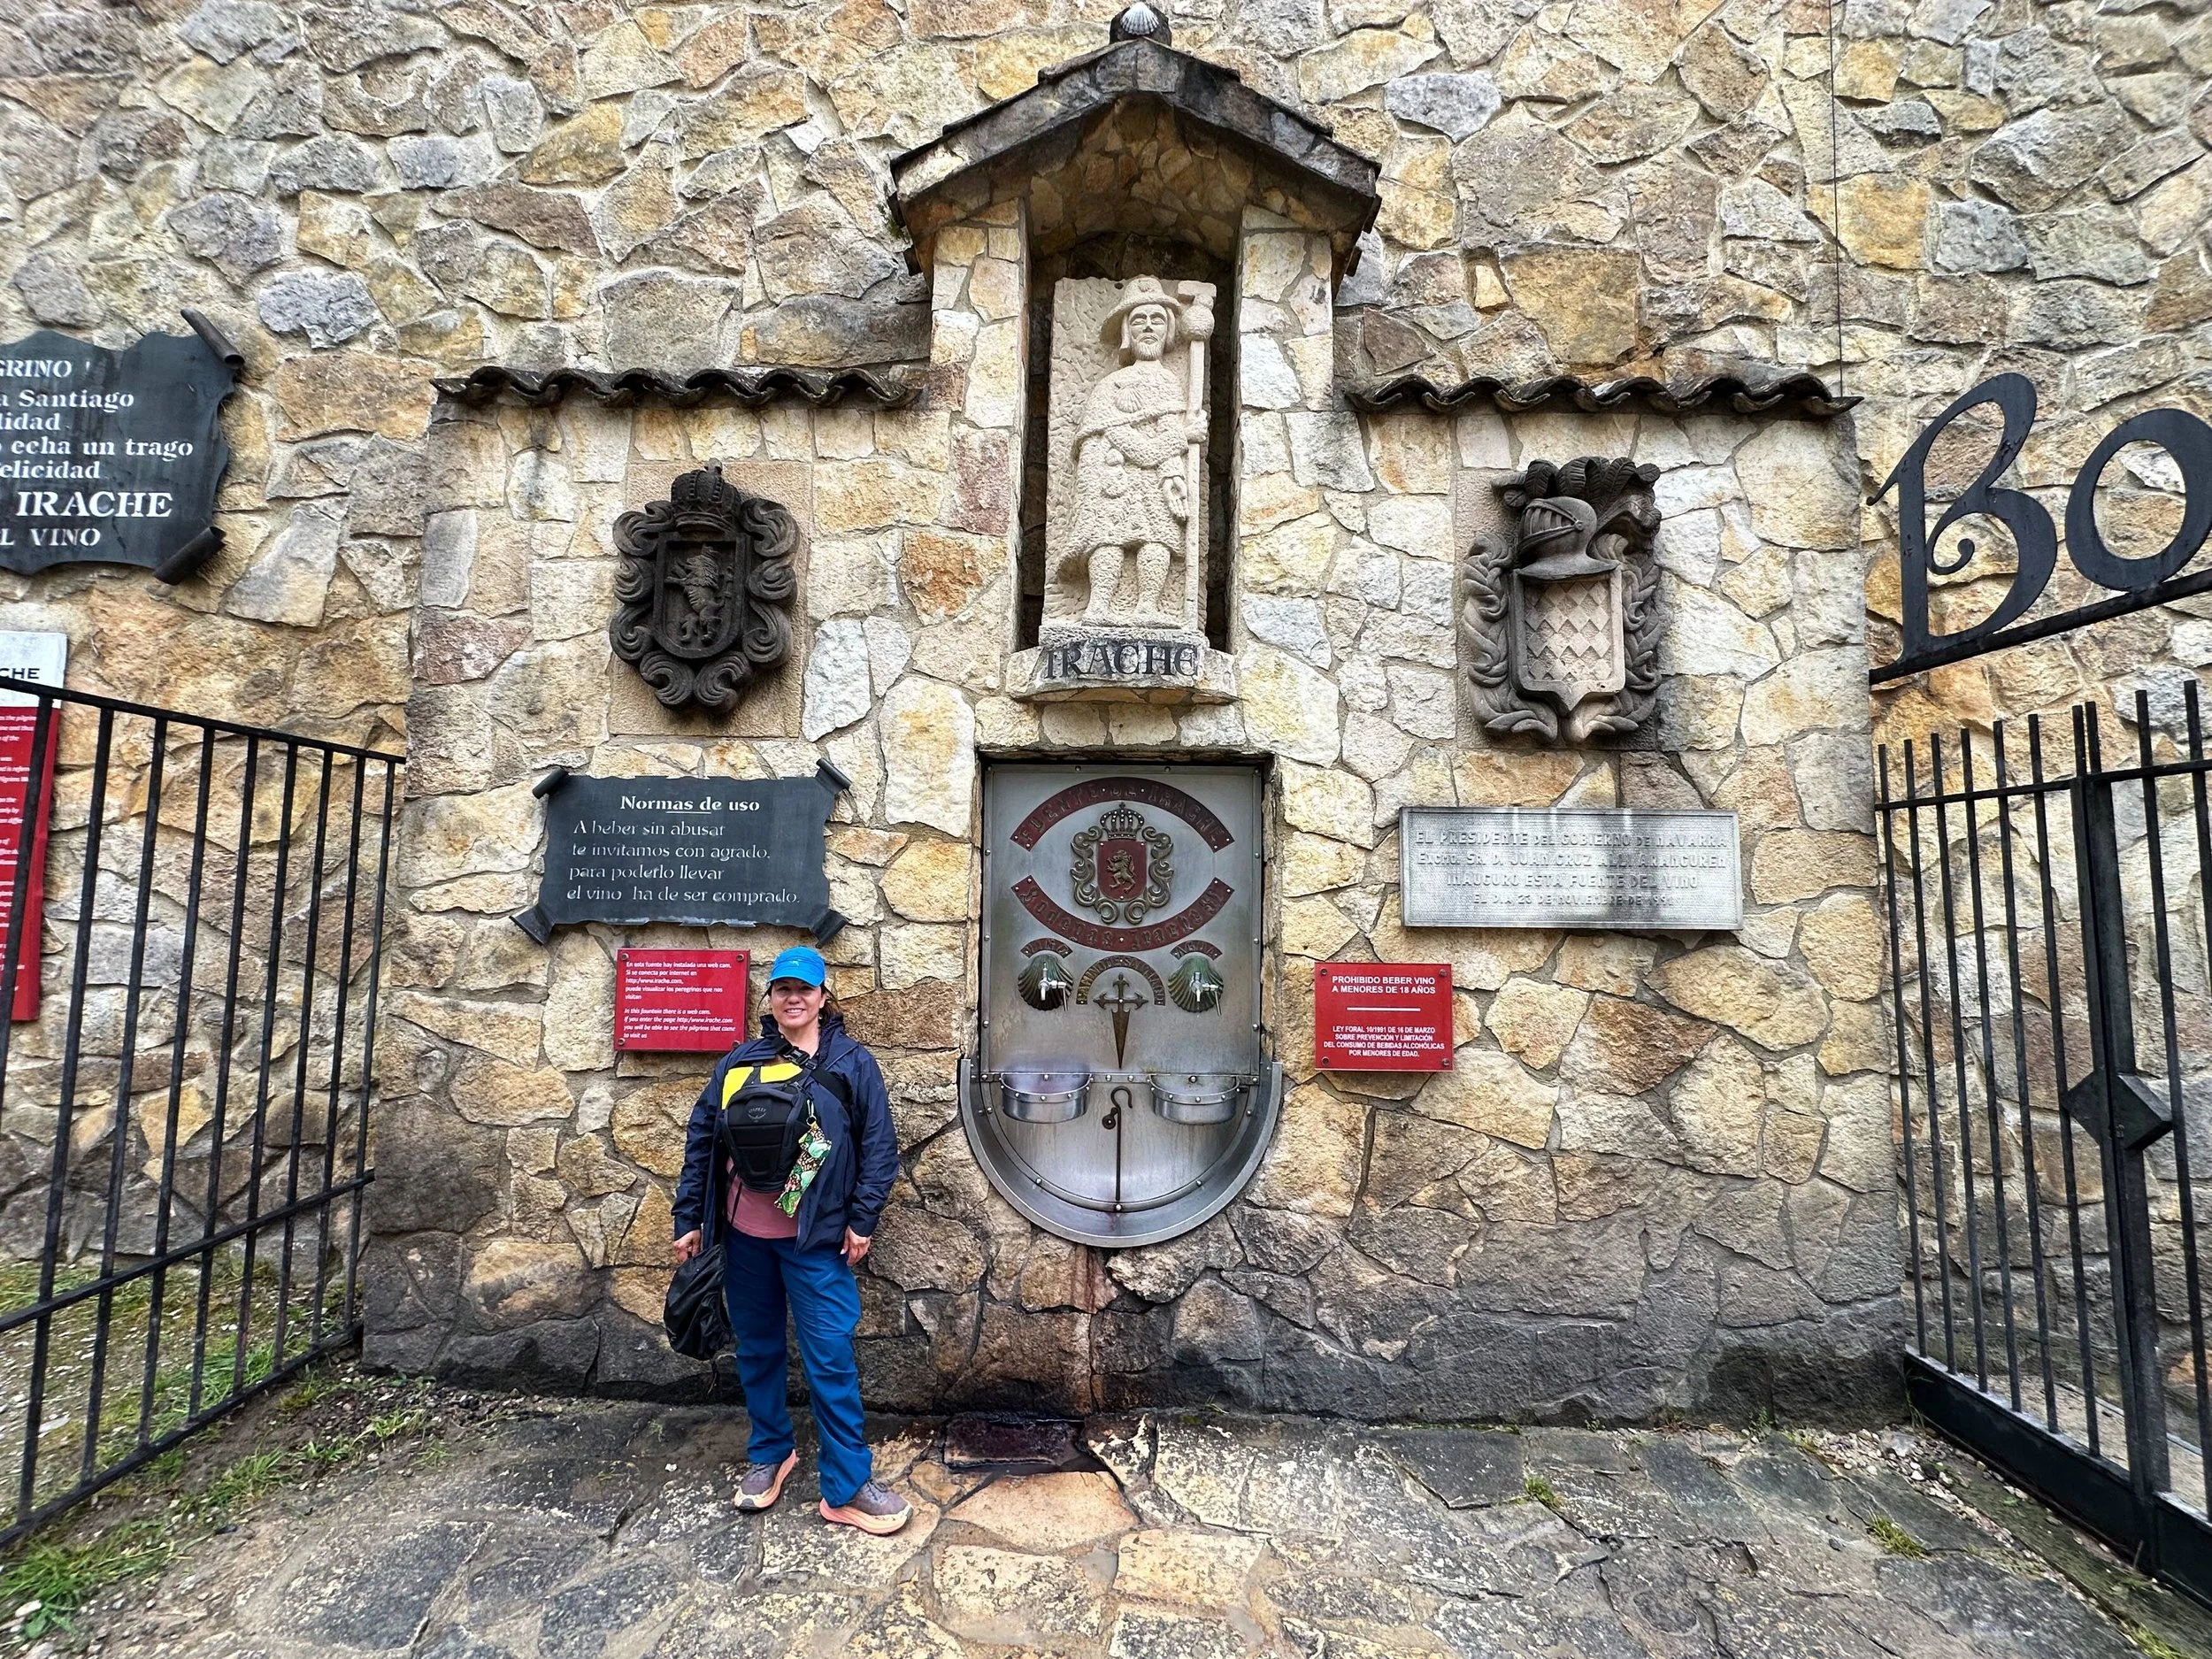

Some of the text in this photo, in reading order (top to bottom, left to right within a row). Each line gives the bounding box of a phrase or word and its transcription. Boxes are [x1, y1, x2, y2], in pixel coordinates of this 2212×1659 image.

[19, 389, 134, 412] Santiago
[11, 436, 71, 454] echa
[82, 442, 115, 456] un
[126, 439, 193, 461] trago
[0, 459, 100, 479] elicidad
[16, 491, 173, 518] IRACHE
[30, 528, 101, 546] VINO
[1045, 644, 1198, 679] IRACHE
[620, 796, 760, 811] Normas de uso
[573, 820, 726, 836] A beber sin abusar
[1416, 831, 1432, 844] EL
[1440, 832, 1528, 845] PRESIDENTE
[1534, 835, 1555, 845] DEL
[1561, 833, 1631, 847] GOBIERNO
[1636, 835, 1650, 847] DE
[572, 844, 587, 856] te
[592, 845, 670, 857] invitamos
[675, 847, 705, 858] con
[569, 865, 725, 881] para poderlo llevar
[1570, 875, 1625, 888] FUENTE
[1629, 875, 1657, 888] DEL
[567, 887, 580, 900] el
[587, 887, 622, 901] vino
[633, 887, 653, 901] ha
[658, 887, 679, 901] de
[684, 891, 708, 902] ser
[1411, 985, 1435, 994] AÑOS
